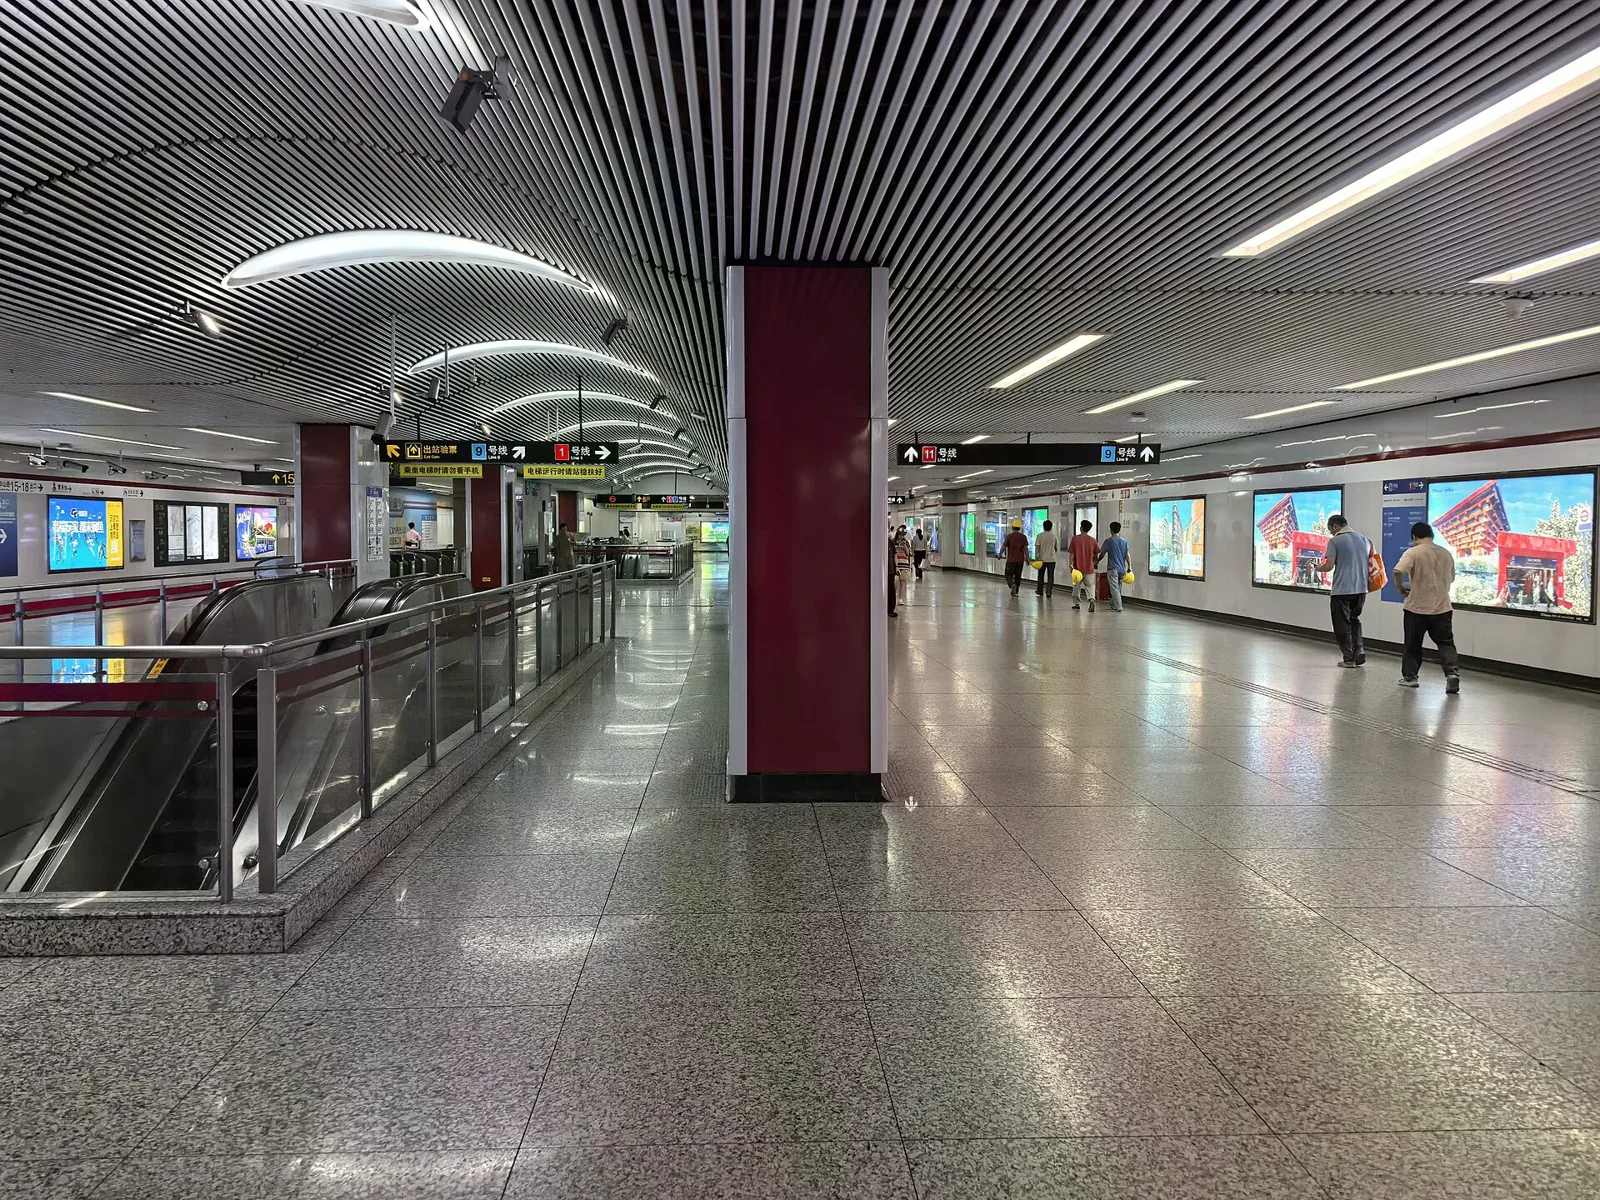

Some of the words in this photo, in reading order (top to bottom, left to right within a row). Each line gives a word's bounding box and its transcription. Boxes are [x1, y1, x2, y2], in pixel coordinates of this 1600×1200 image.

[423, 445, 457, 455] 出站验票
[475, 446, 483, 456] 9
[487, 445, 508, 456] 号线
[559, 447, 564, 457] 1
[570, 446, 590, 456] 号线
[924, 449, 934, 459] 11
[938, 447, 957, 458] 号线
[1105, 449, 1112, 459] 9
[1117, 447, 1136, 458] 号线
[527, 467, 602, 476] 电梯运行时请站稳扶好
[281, 473, 296, 485] 15
[11, 481, 29, 492] 15-18
